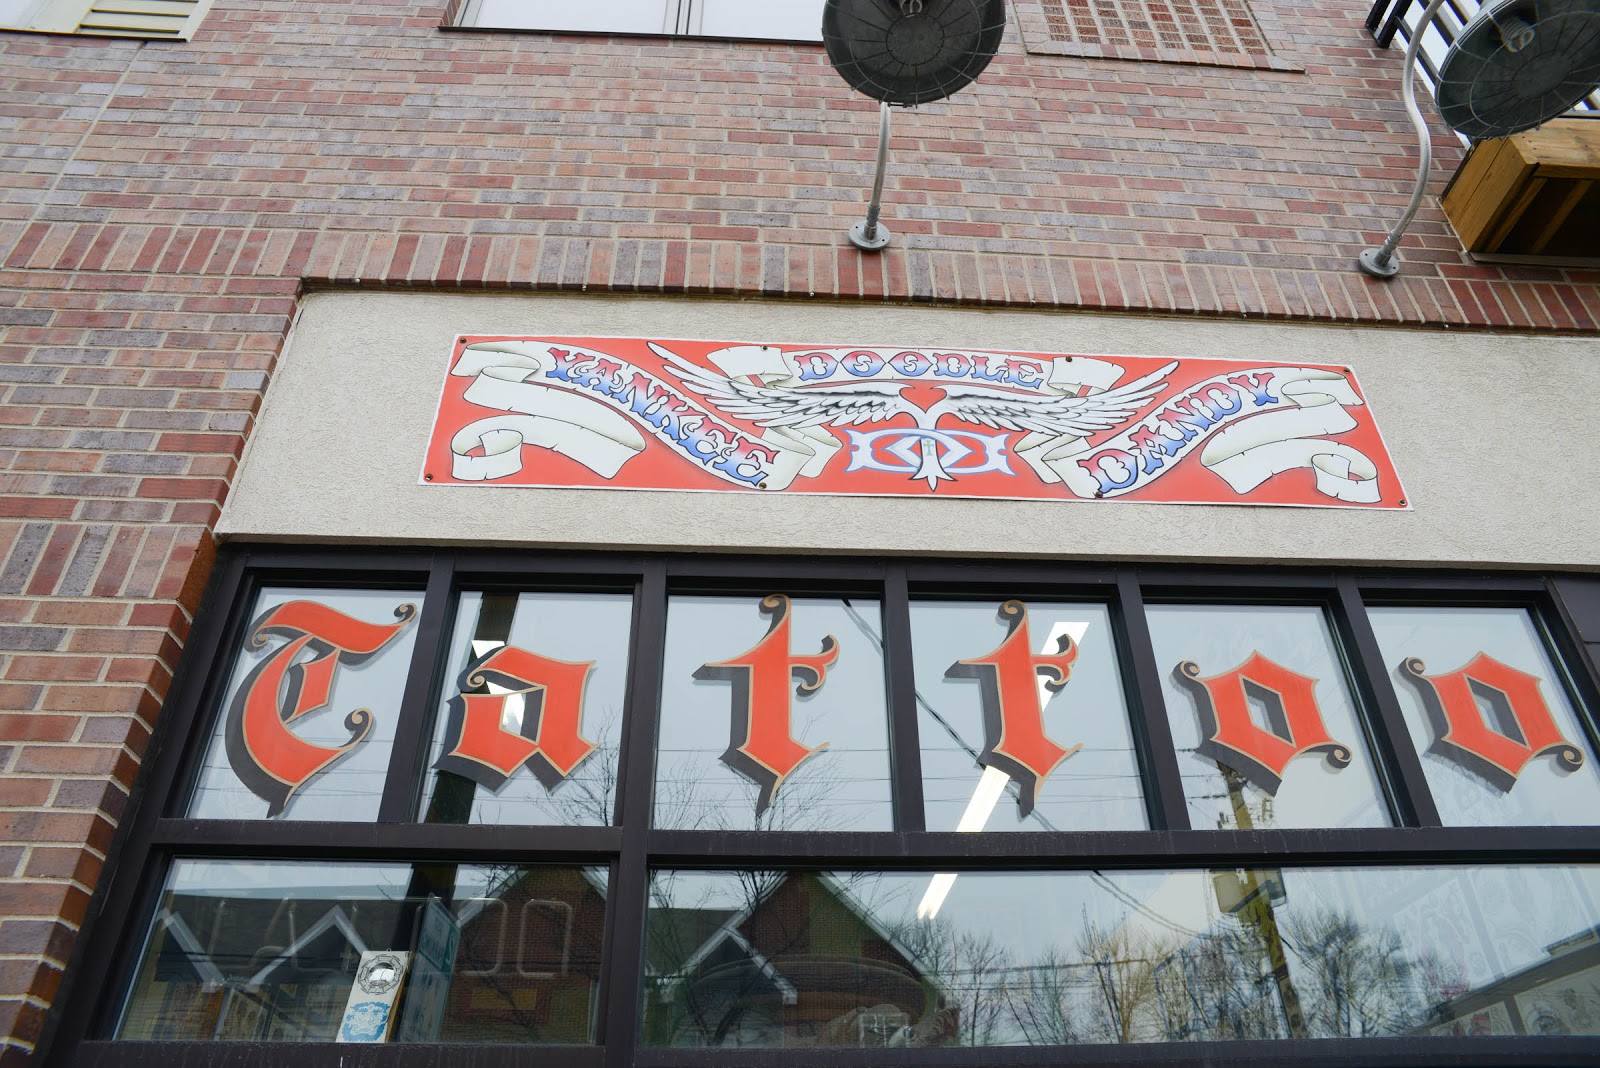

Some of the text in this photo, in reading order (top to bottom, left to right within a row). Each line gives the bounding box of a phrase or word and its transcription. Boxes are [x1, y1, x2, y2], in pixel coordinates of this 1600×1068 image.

[545, 347, 781, 487] YANKEE
[794, 350, 1044, 389] DOODLE
[1078, 372, 1279, 494] DANDY
[226, 594, 1584, 819] Tattoo
